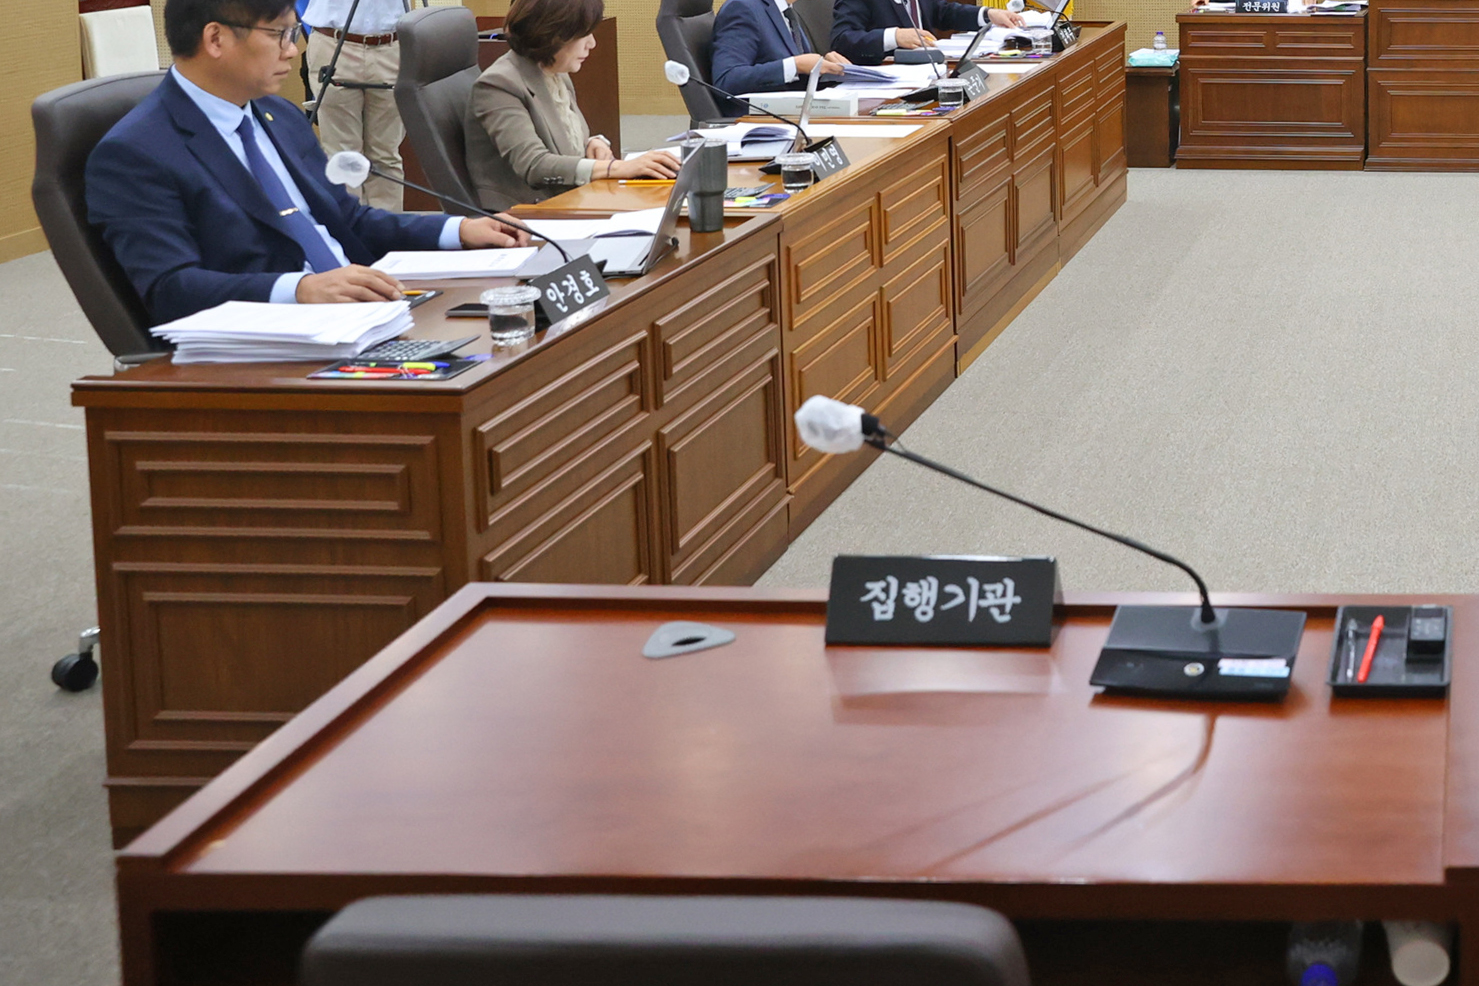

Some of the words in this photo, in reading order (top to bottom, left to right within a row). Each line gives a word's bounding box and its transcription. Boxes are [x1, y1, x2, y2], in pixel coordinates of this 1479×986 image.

[1242, 0, 1281, 13] 전문위원
[545, 269, 601, 313] 안경호
[859, 574, 1023, 624] 집행기관
